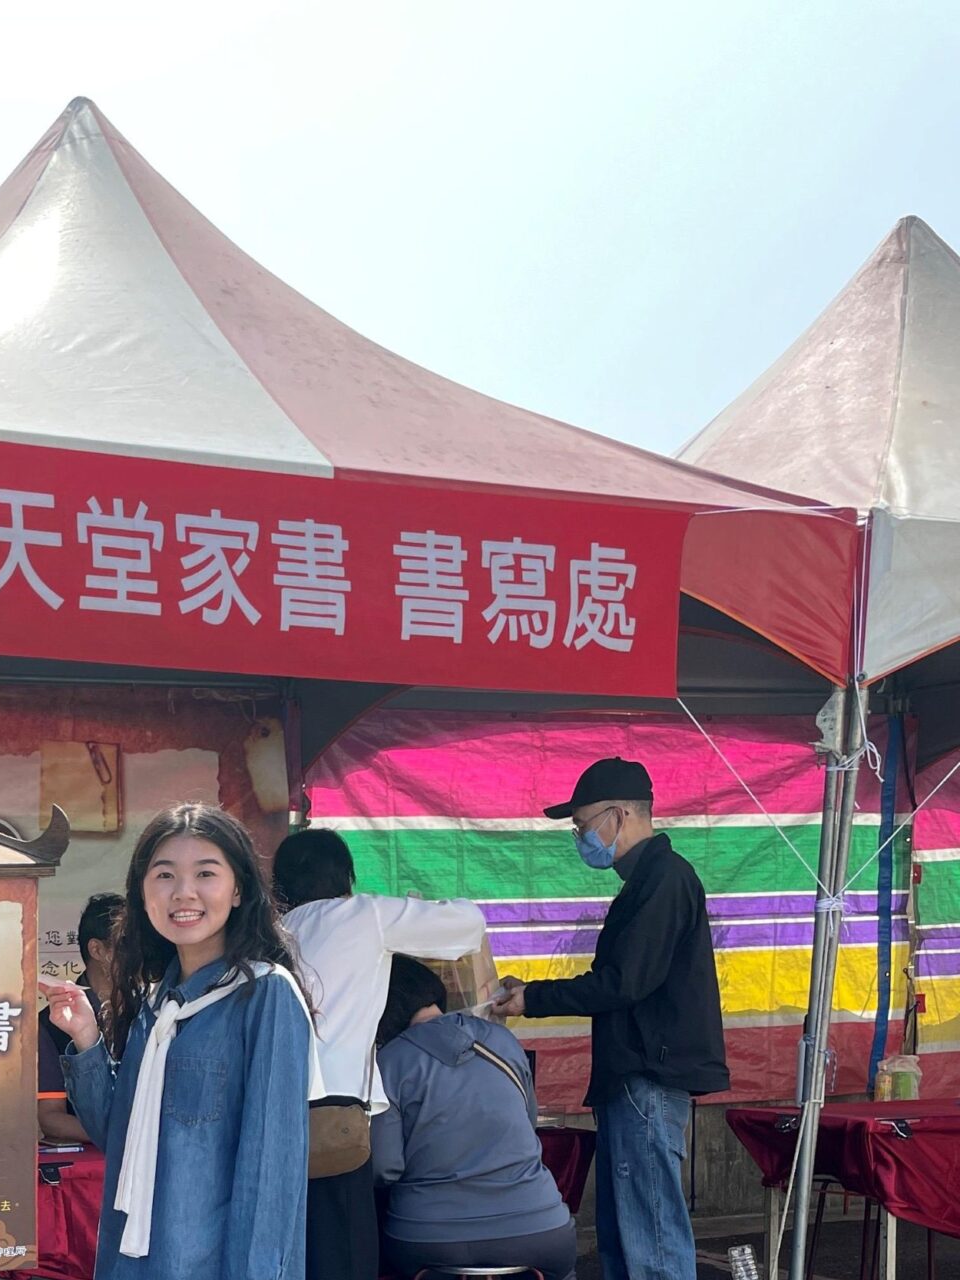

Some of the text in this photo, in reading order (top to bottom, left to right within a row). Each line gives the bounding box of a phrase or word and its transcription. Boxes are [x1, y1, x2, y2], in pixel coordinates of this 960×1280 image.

[393, 529, 638, 653] 書寫處
[41, 960, 82, 977] 念化
